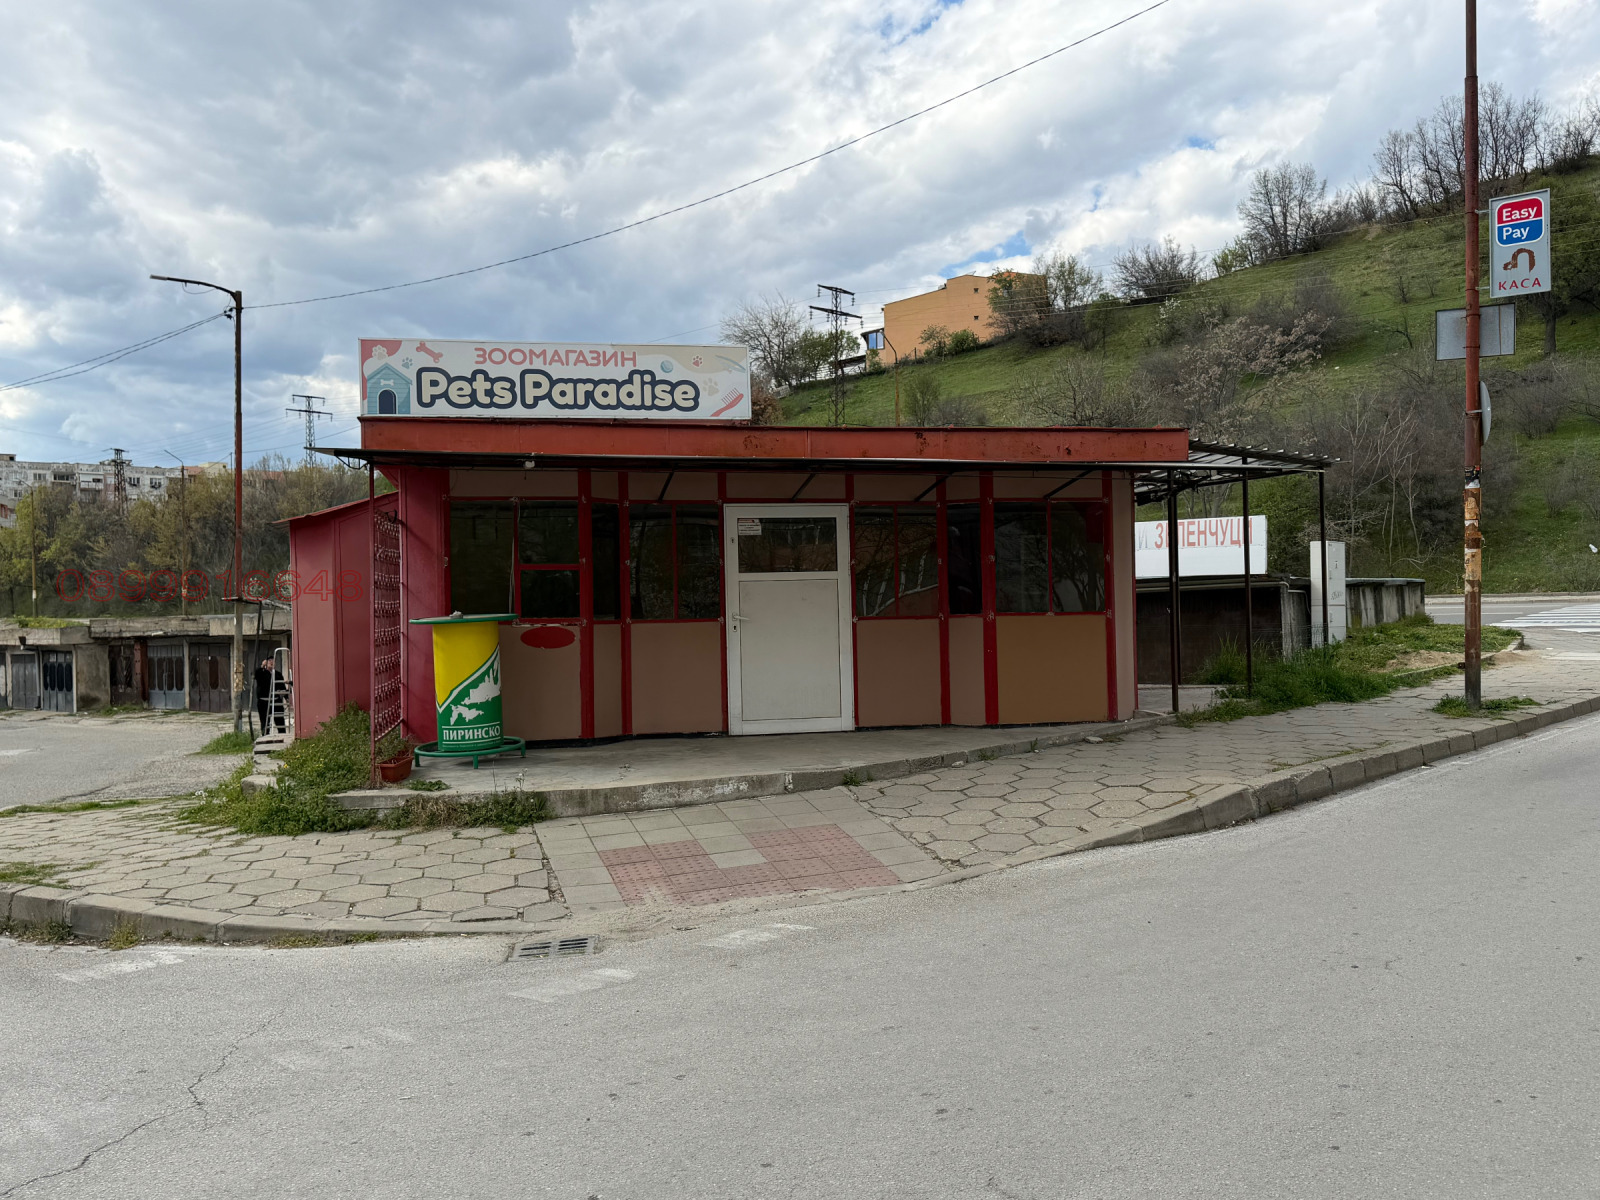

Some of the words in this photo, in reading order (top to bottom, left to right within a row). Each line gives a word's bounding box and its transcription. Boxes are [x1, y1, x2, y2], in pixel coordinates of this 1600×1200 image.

[1502, 205, 1538, 221] Easy
[1502, 226, 1530, 240] Pay
[1498, 277, 1542, 291] КАСА
[474, 347, 637, 367] ЗООМАГАЗИН
[418, 368, 514, 408] Pets
[522, 370, 698, 410] Paradise
[443, 725, 501, 740] ПИРИНСКО
